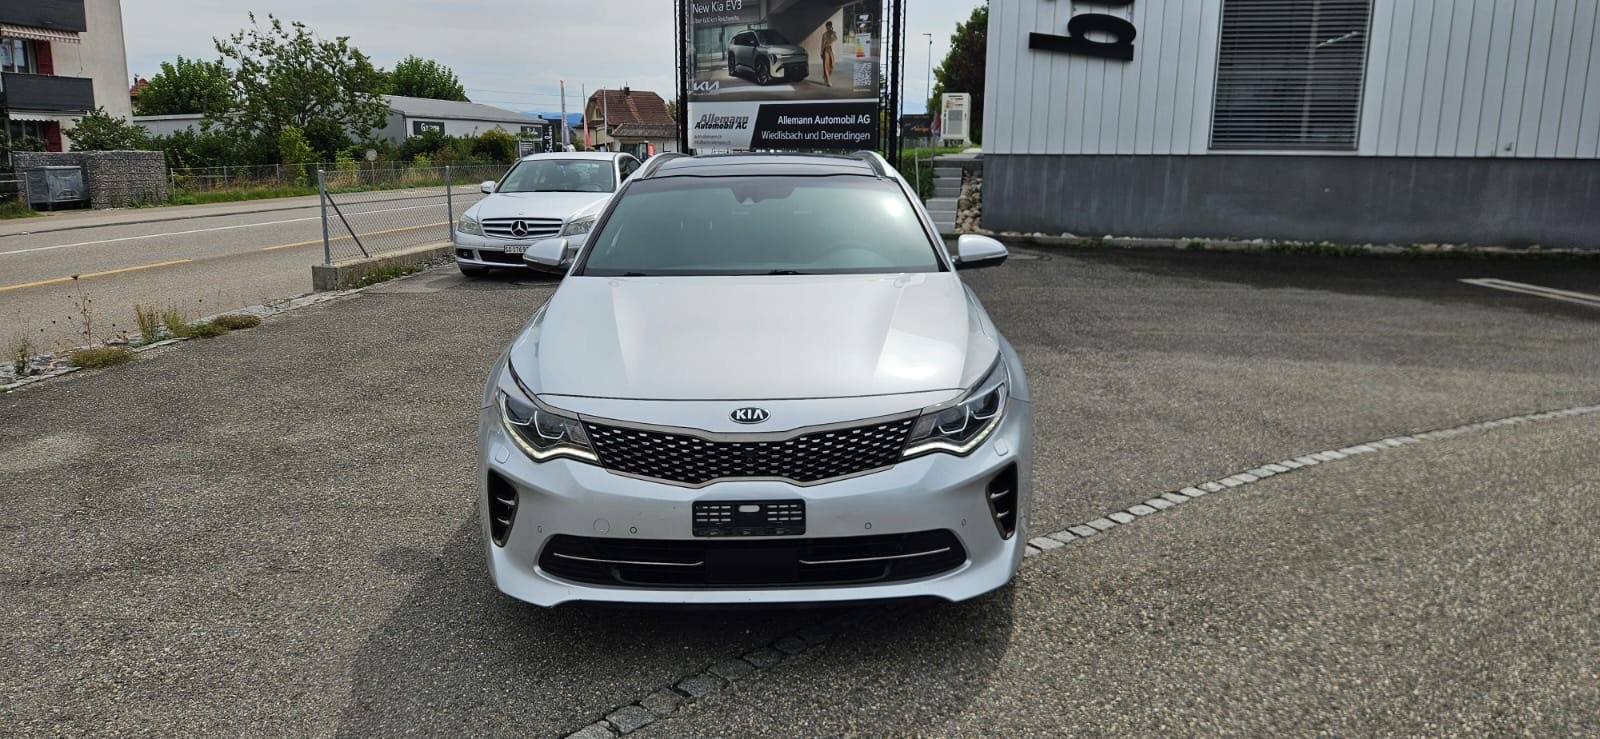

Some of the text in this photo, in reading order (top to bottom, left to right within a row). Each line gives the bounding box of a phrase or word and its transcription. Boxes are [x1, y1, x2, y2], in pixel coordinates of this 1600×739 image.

[692, 0, 742, 14] New Kia EV3
[694, 80, 720, 91] KIA
[700, 113, 749, 123] Allemann
[777, 114, 871, 125] Allemann Automobil AG
[694, 121, 748, 130] Automobil AG
[761, 130, 871, 142] Wiedlisbach und Derendingen
[736, 408, 764, 419] KIA
